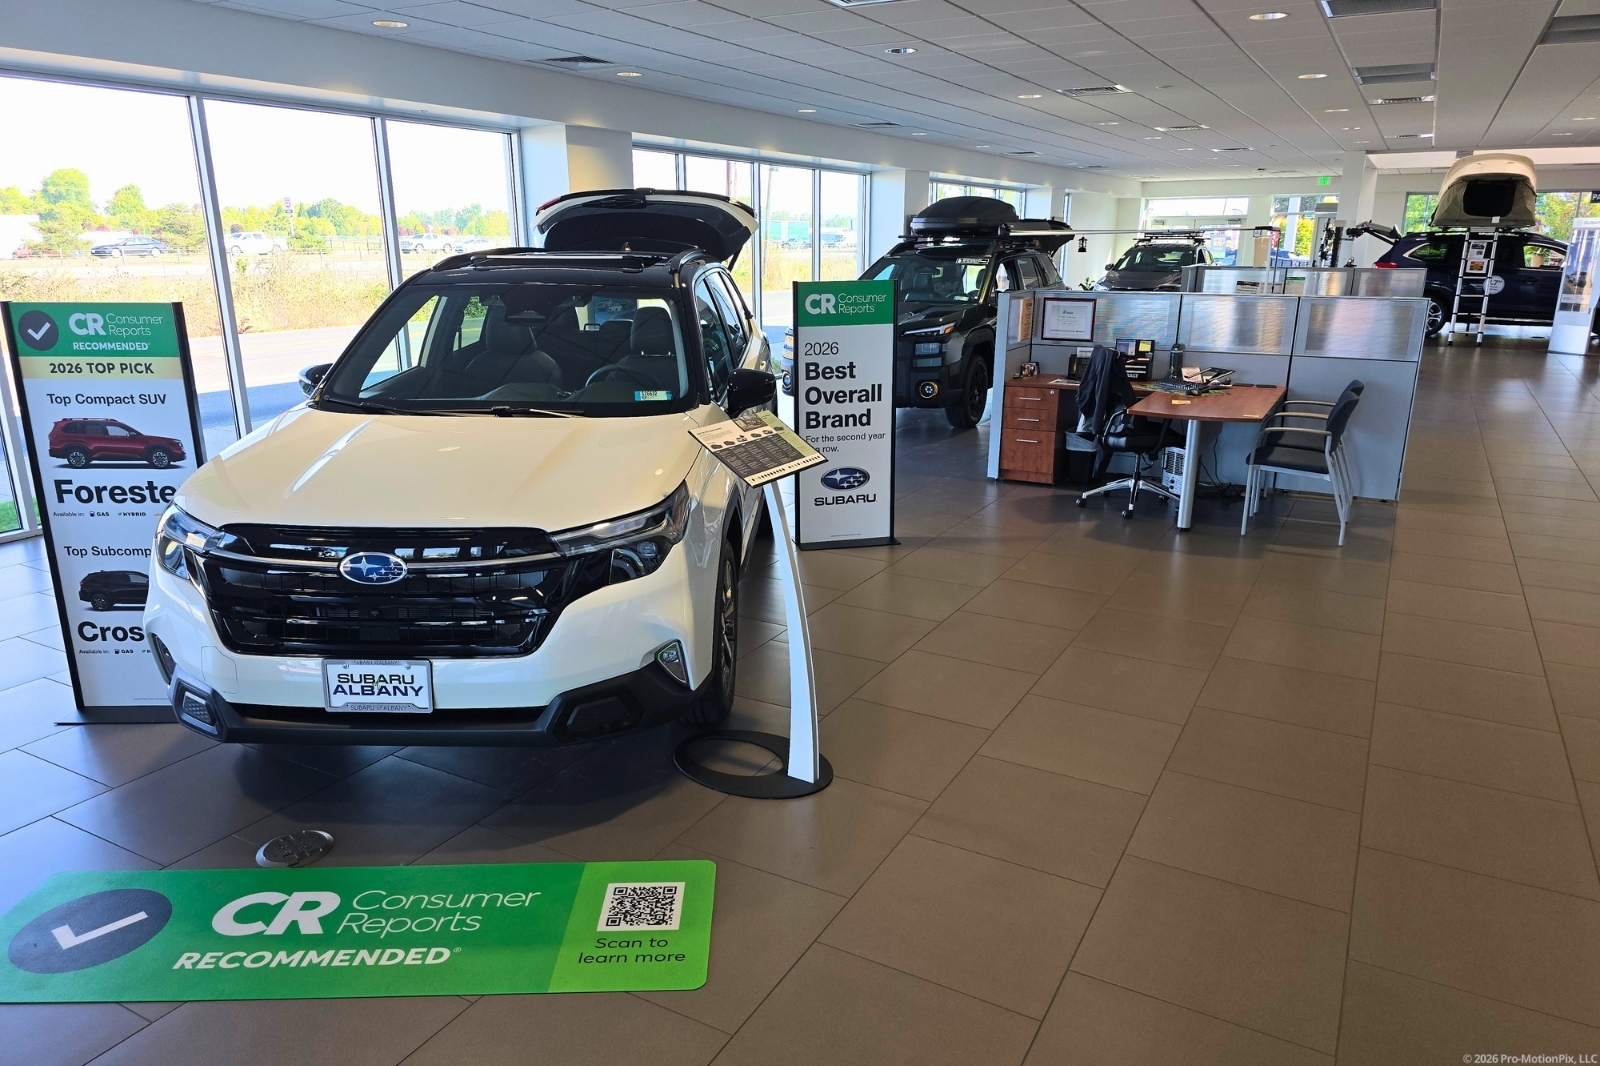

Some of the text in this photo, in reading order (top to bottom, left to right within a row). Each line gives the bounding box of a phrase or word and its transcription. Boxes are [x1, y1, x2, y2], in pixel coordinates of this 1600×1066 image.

[804, 293, 837, 315] CR
[837, 292, 887, 304] Consumer
[838, 303, 875, 316] Reports
[68, 312, 107, 336] CR
[105, 313, 164, 325] Consumer
[108, 324, 152, 339] Reports
[72, 342, 150, 351] RECOMMENDED
[804, 341, 840, 356] 2026
[49, 362, 155, 374] 2026 TOP PICK
[804, 361, 857, 381] Best
[46, 393, 167, 407] Top Compact SUV
[804, 383, 883, 406] Overall
[805, 408, 872, 430] Brand
[805, 433, 886, 443] For the second year
[53, 479, 178, 504] Foreste
[813, 493, 877, 507] SUBARU
[63, 545, 152, 558] Top Subcomp
[77, 621, 145, 643] Cros
[336, 673, 415, 685] SUBARU
[332, 684, 424, 697] ALBANY
[352, 890, 542, 911] Consumer
[211, 891, 342, 937] CR
[336, 911, 483, 939] Reports
[594, 937, 669, 949] Scan to
[578, 952, 686, 964] learn more
